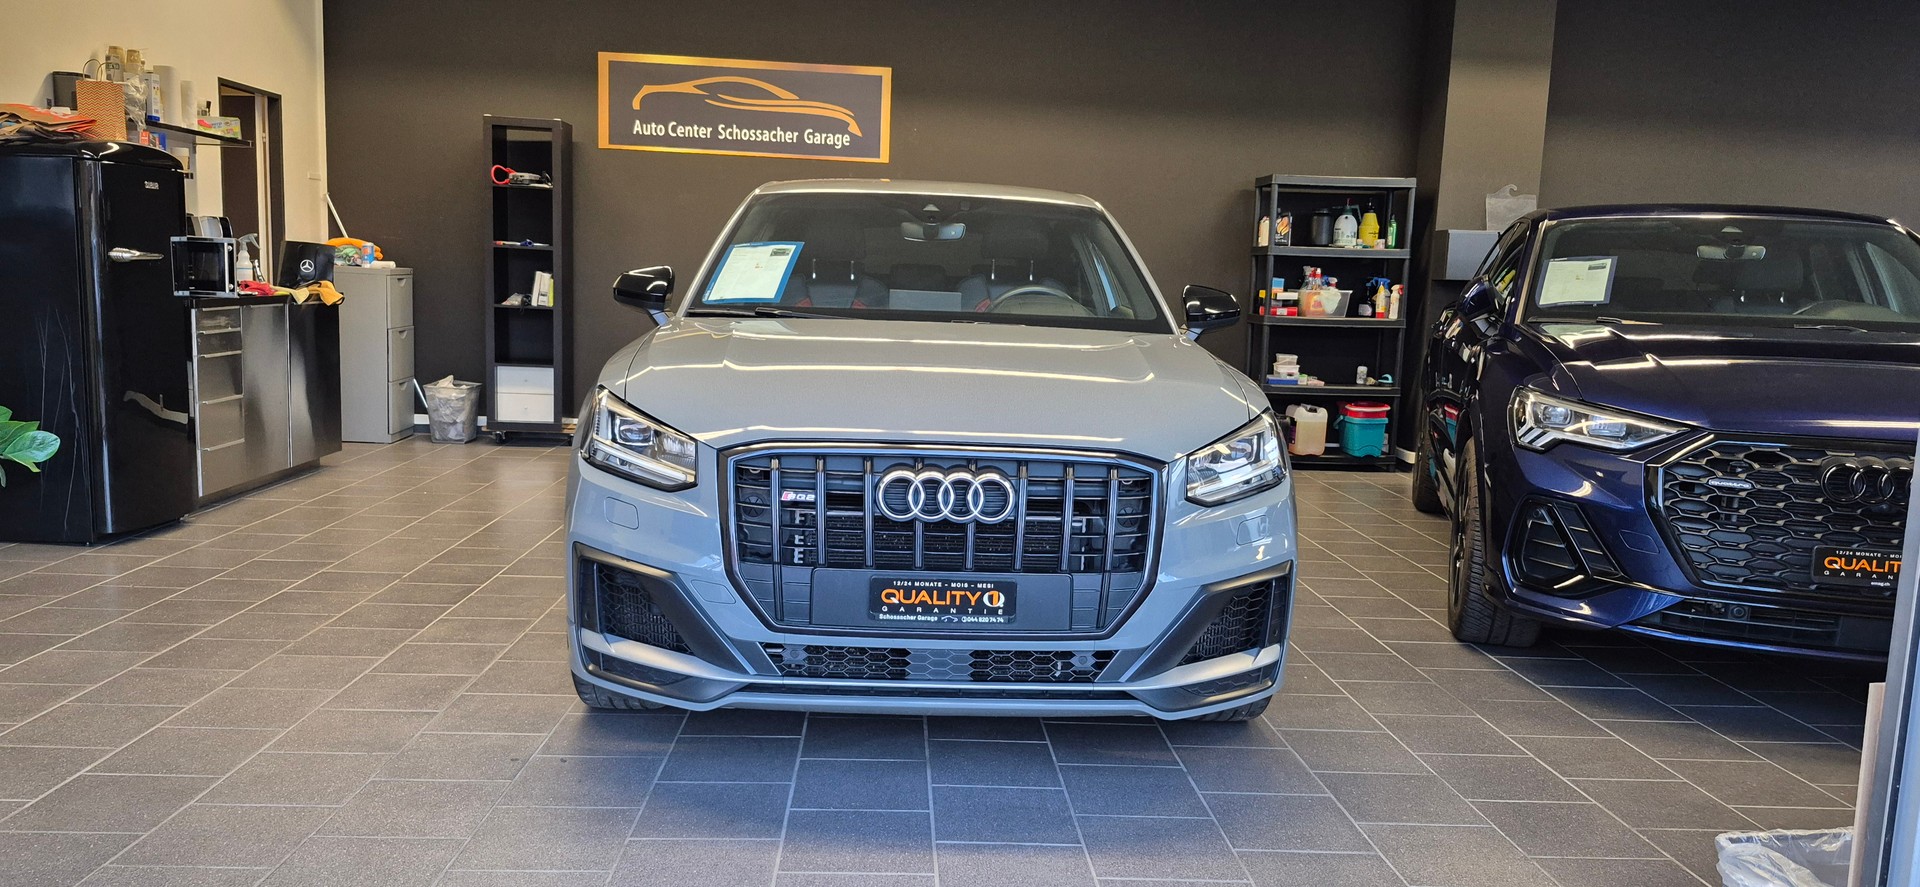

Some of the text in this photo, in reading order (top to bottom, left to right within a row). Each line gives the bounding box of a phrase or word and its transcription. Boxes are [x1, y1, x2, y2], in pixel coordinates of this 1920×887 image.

[633, 119, 850, 149] Auto Center Schossacher Garage
[1855, 550, 1882, 558] MONATE
[1824, 556, 1903, 573] QUALIT
[881, 589, 982, 606] QUALITY
[881, 605, 1004, 615] GARANTIE
[917, 614, 938, 622] Garage
